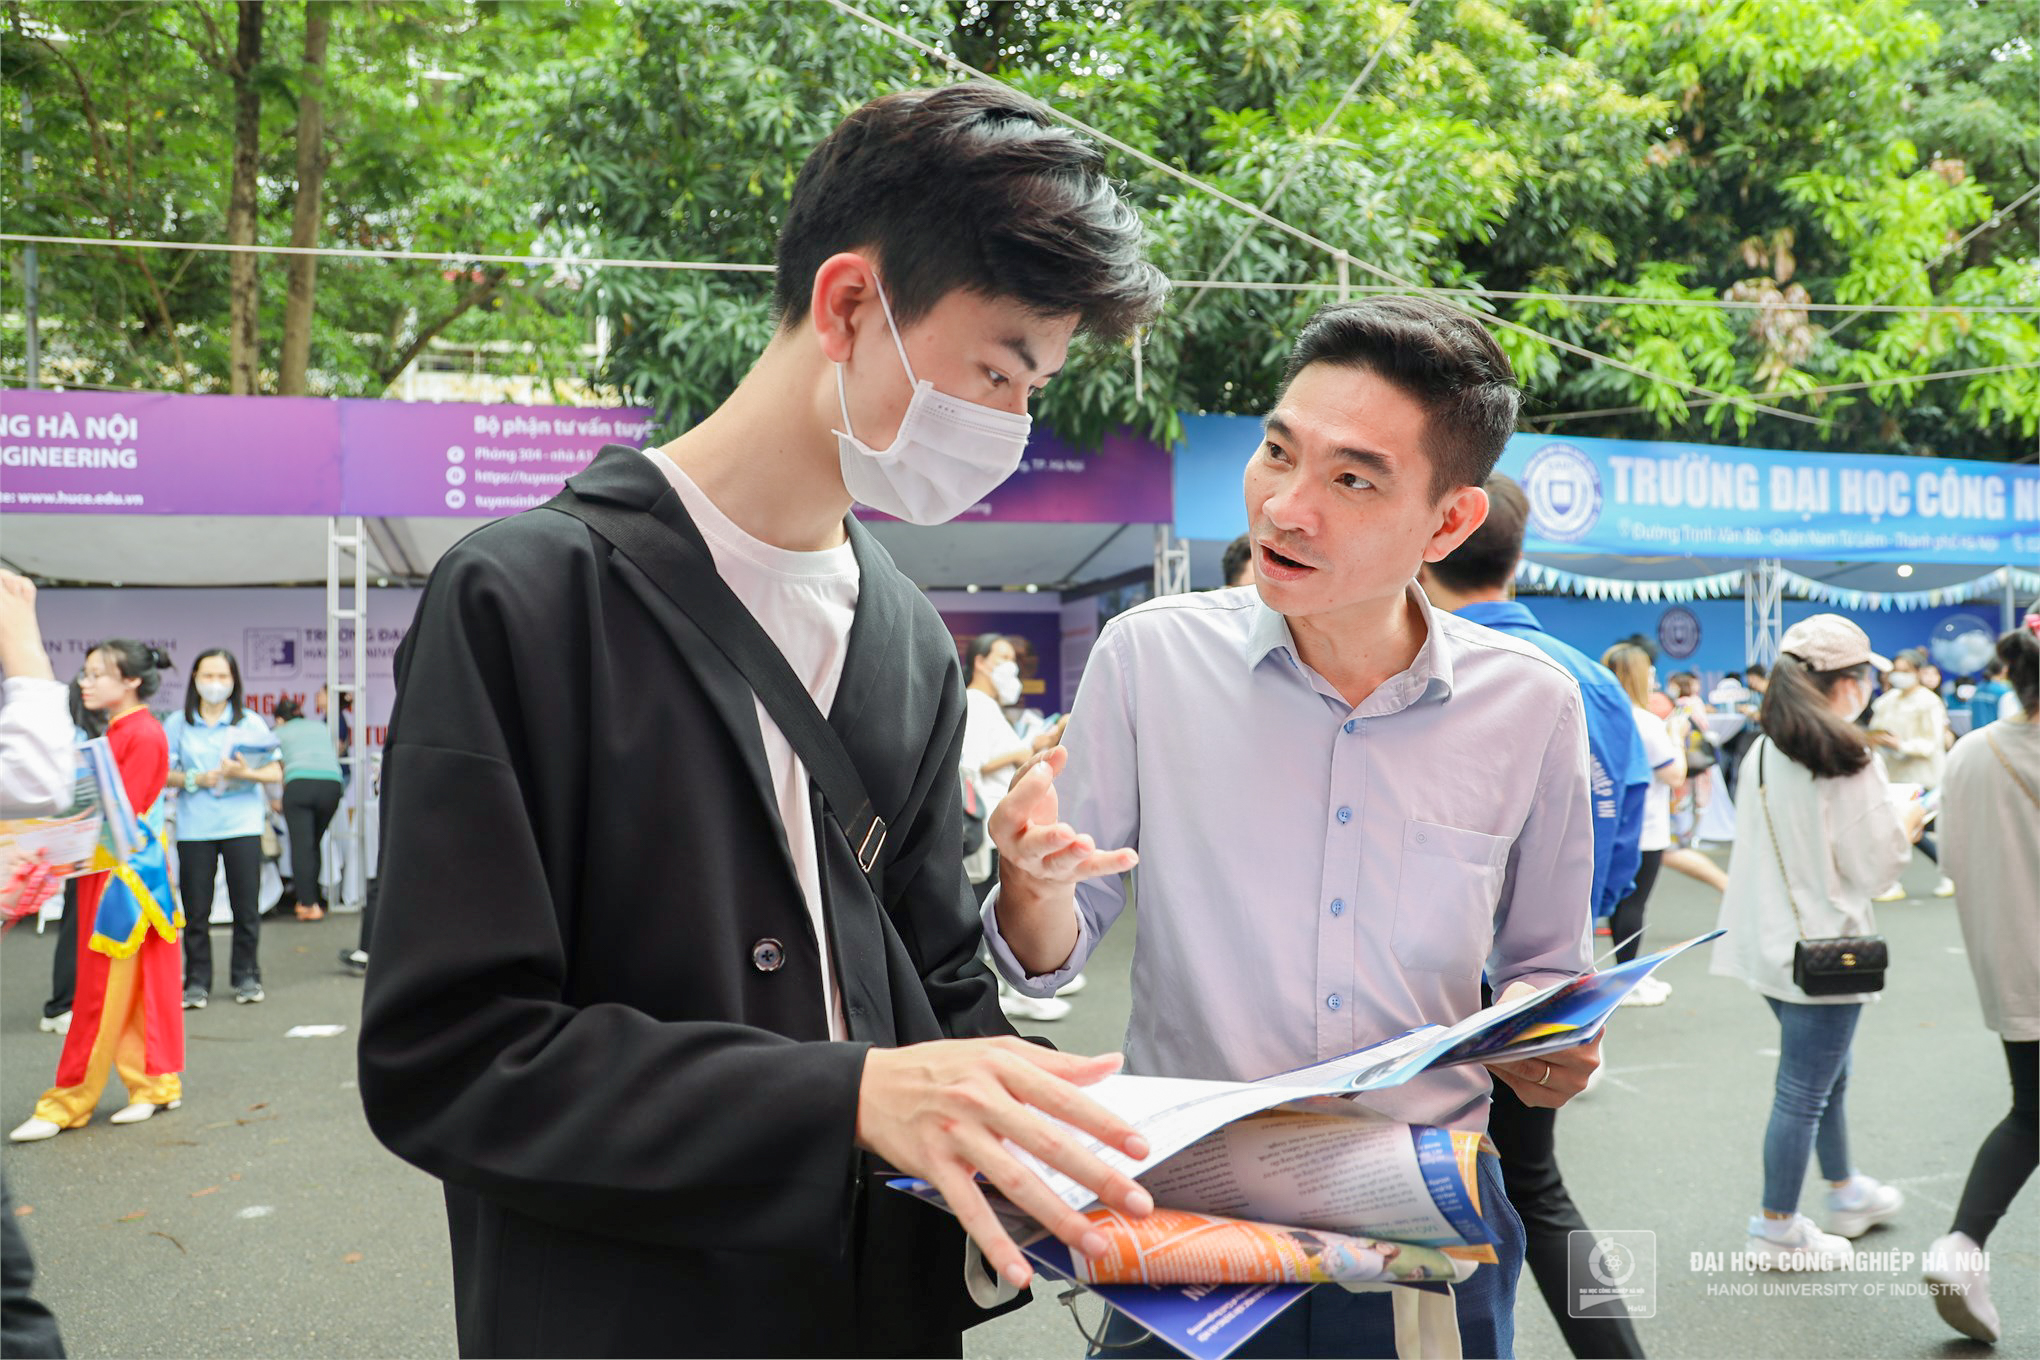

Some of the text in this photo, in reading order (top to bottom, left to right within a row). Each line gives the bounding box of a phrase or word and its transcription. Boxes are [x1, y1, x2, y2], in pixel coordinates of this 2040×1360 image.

[37, 411, 80, 439] HÀ
[85, 412, 139, 446] NỘI
[474, 415, 500, 438] Bộ
[502, 416, 550, 439] phận
[578, 416, 612, 437] vấn
[0, 445, 138, 469] GINEERING
[1608, 453, 1760, 511] TRƯỜNG
[1769, 465, 1829, 522] ĐẠI
[1840, 468, 1911, 524] HỌC
[1916, 466, 2006, 520] CÔNG
